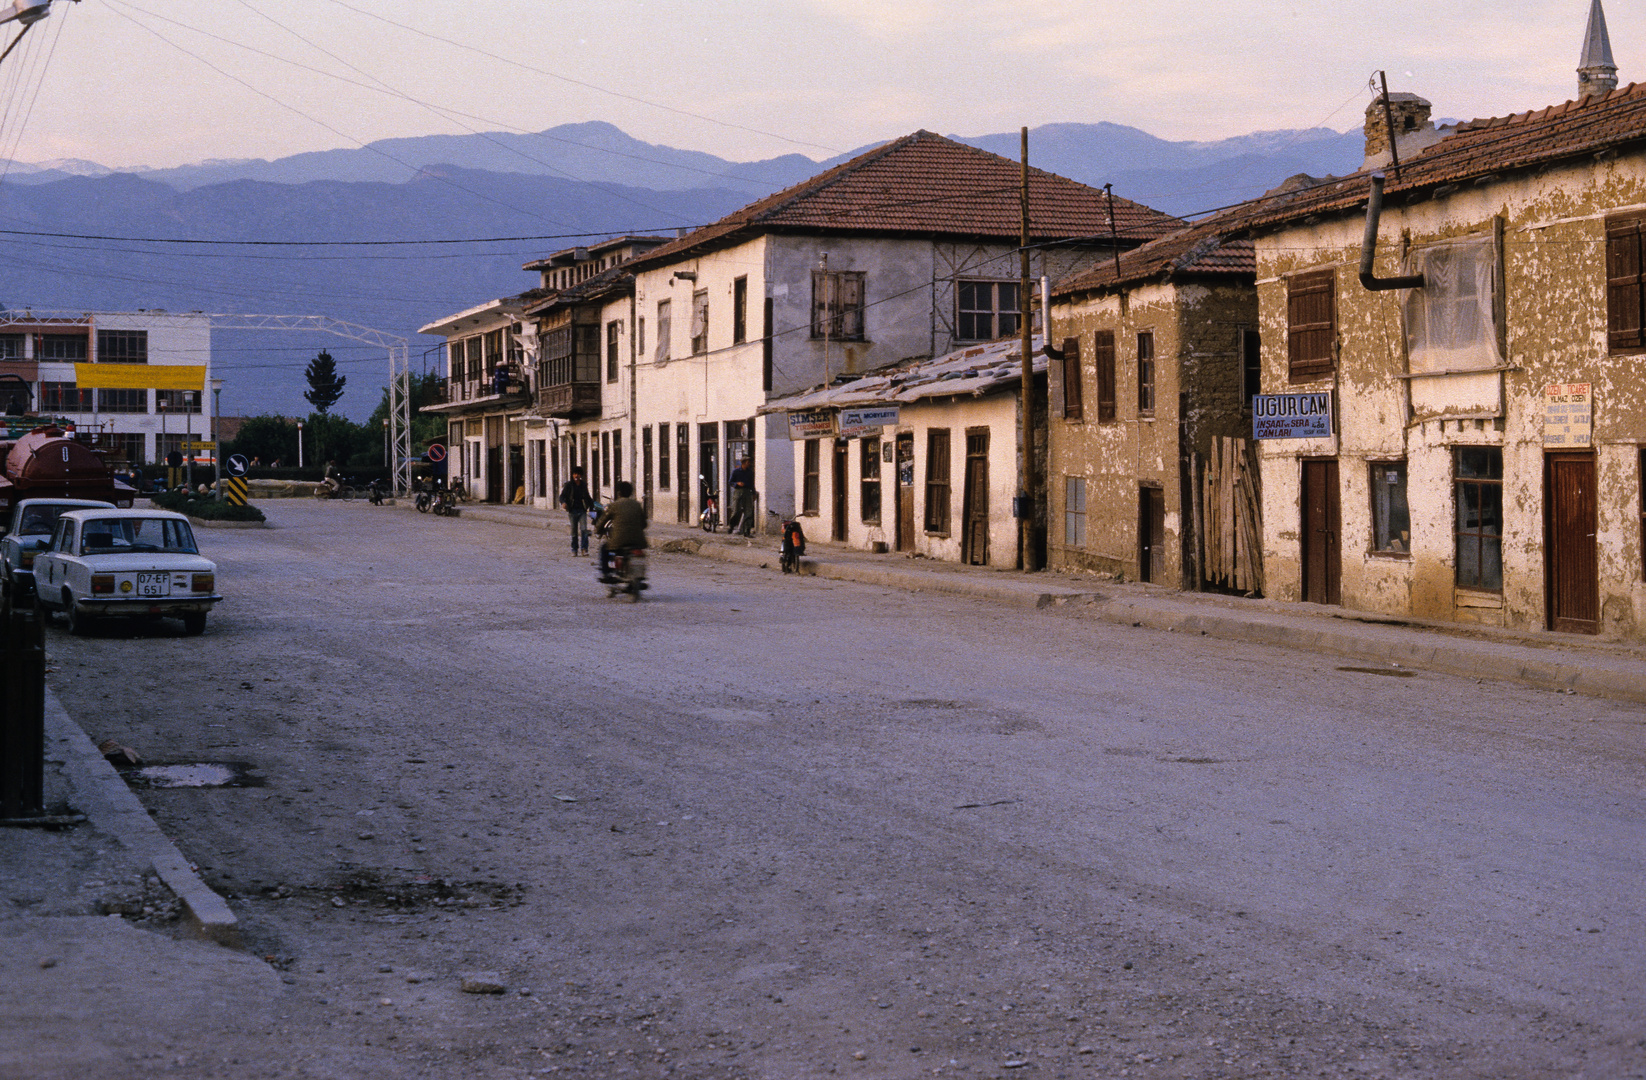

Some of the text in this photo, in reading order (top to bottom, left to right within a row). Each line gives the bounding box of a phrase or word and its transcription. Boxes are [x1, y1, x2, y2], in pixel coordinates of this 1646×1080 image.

[1256, 394, 1329, 417] UĞUR CAM
[863, 411, 896, 419] MOBYLETTE
[1257, 418, 1285, 430] İNŞAAT
[1291, 419, 1309, 428] SERA
[1257, 429, 1292, 438] CAMLARI
[140, 575, 168, 584] 07-EF
[144, 585, 162, 594] 651
